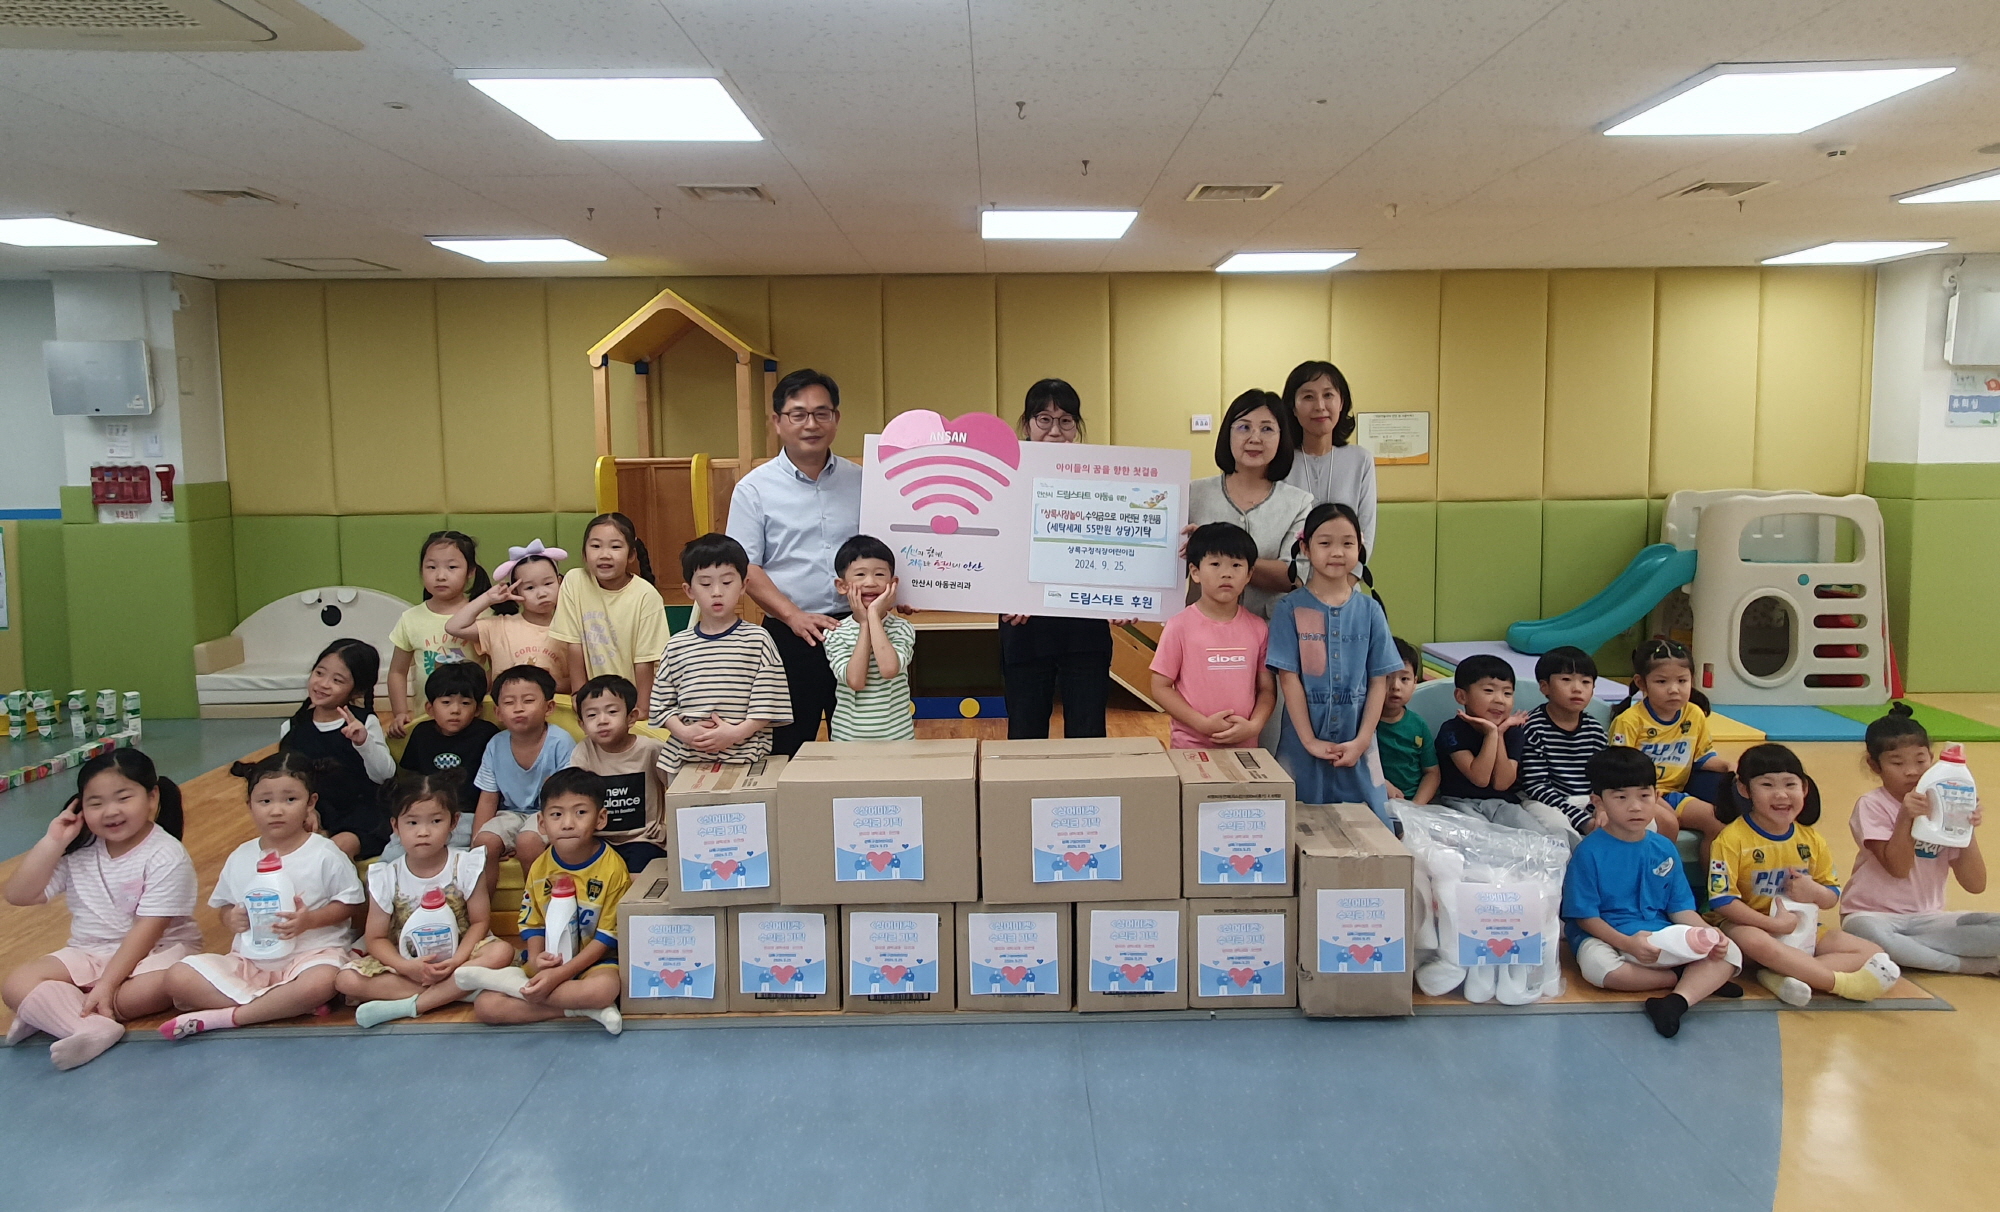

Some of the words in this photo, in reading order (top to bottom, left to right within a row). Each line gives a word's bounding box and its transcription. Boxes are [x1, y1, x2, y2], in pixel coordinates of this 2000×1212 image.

[930, 431, 967, 444] ANSAN
[1056, 463, 1090, 473] 아이들의
[1093, 465, 1110, 475] 꿈을
[1113, 466, 1130, 476] 향한
[1133, 467, 1158, 477] 첫걸음
[1056, 489, 1092, 500] 드림스타트
[1094, 492, 1114, 501] 아동을
[1119, 513, 1140, 523] 마련된
[1142, 514, 1162, 525] 후원품
[1047, 521, 1082, 534] (세탁세제
[1086, 524, 1112, 535] 55만원
[1067, 546, 1135, 557] 상록구청직장어린이집
[963, 561, 985, 572] 안산
[1074, 559, 1097, 570] 2024.
[911, 578, 933, 588] 안산시
[935, 580, 971, 590] 아동권리과
[1069, 592, 1125, 606] 드림스타트
[1131, 596, 1153, 609] 후원
[606, 787, 629, 797] new
[603, 796, 641, 808] alance
[853, 817, 880, 827] 수익금
[1051, 818, 1078, 827] 수익금
[1217, 821, 1244, 830] 수익금
[697, 825, 725, 836] 수익금
[1109, 931, 1136, 940] 수익금
